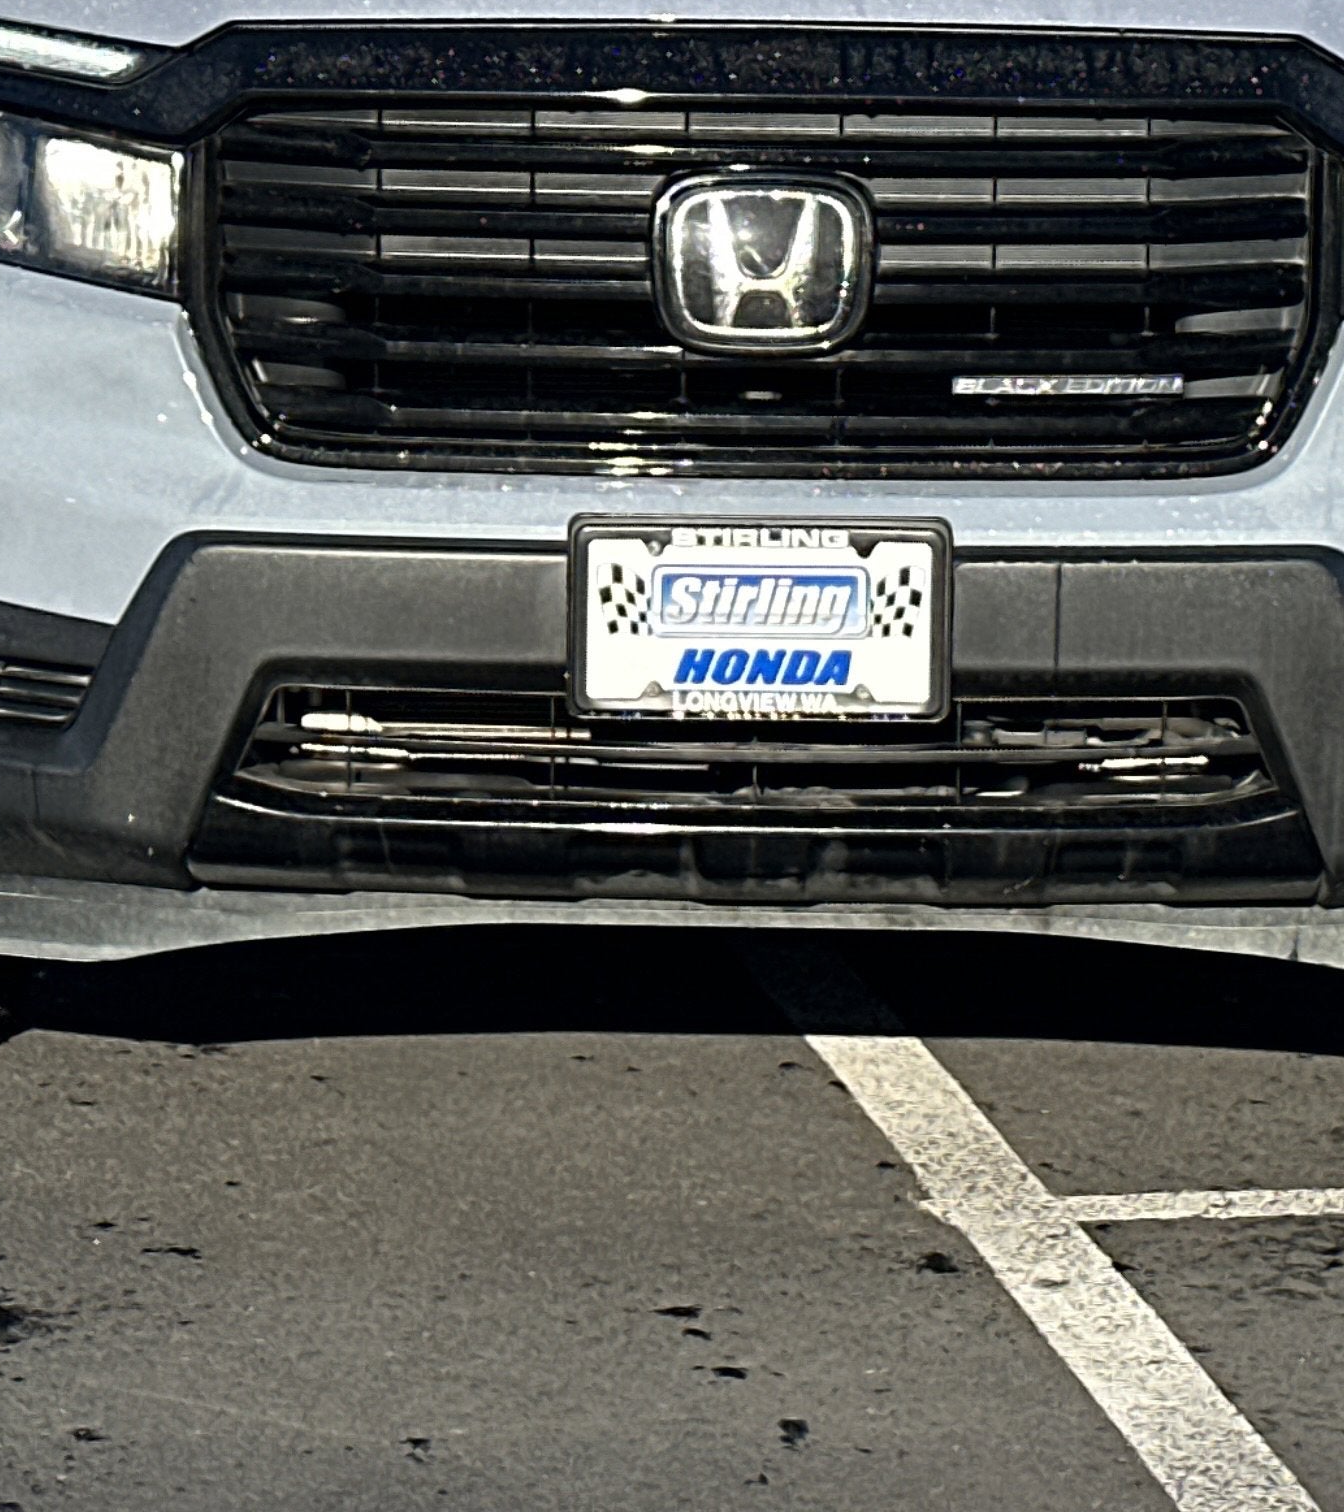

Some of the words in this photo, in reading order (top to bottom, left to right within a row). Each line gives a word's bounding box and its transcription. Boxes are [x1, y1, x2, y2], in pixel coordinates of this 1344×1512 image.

[1062, 377, 1183, 394] EDITION
[671, 528, 849, 549] STIRLING
[667, 575, 853, 630] Stirling
[673, 648, 853, 686] HONDA
